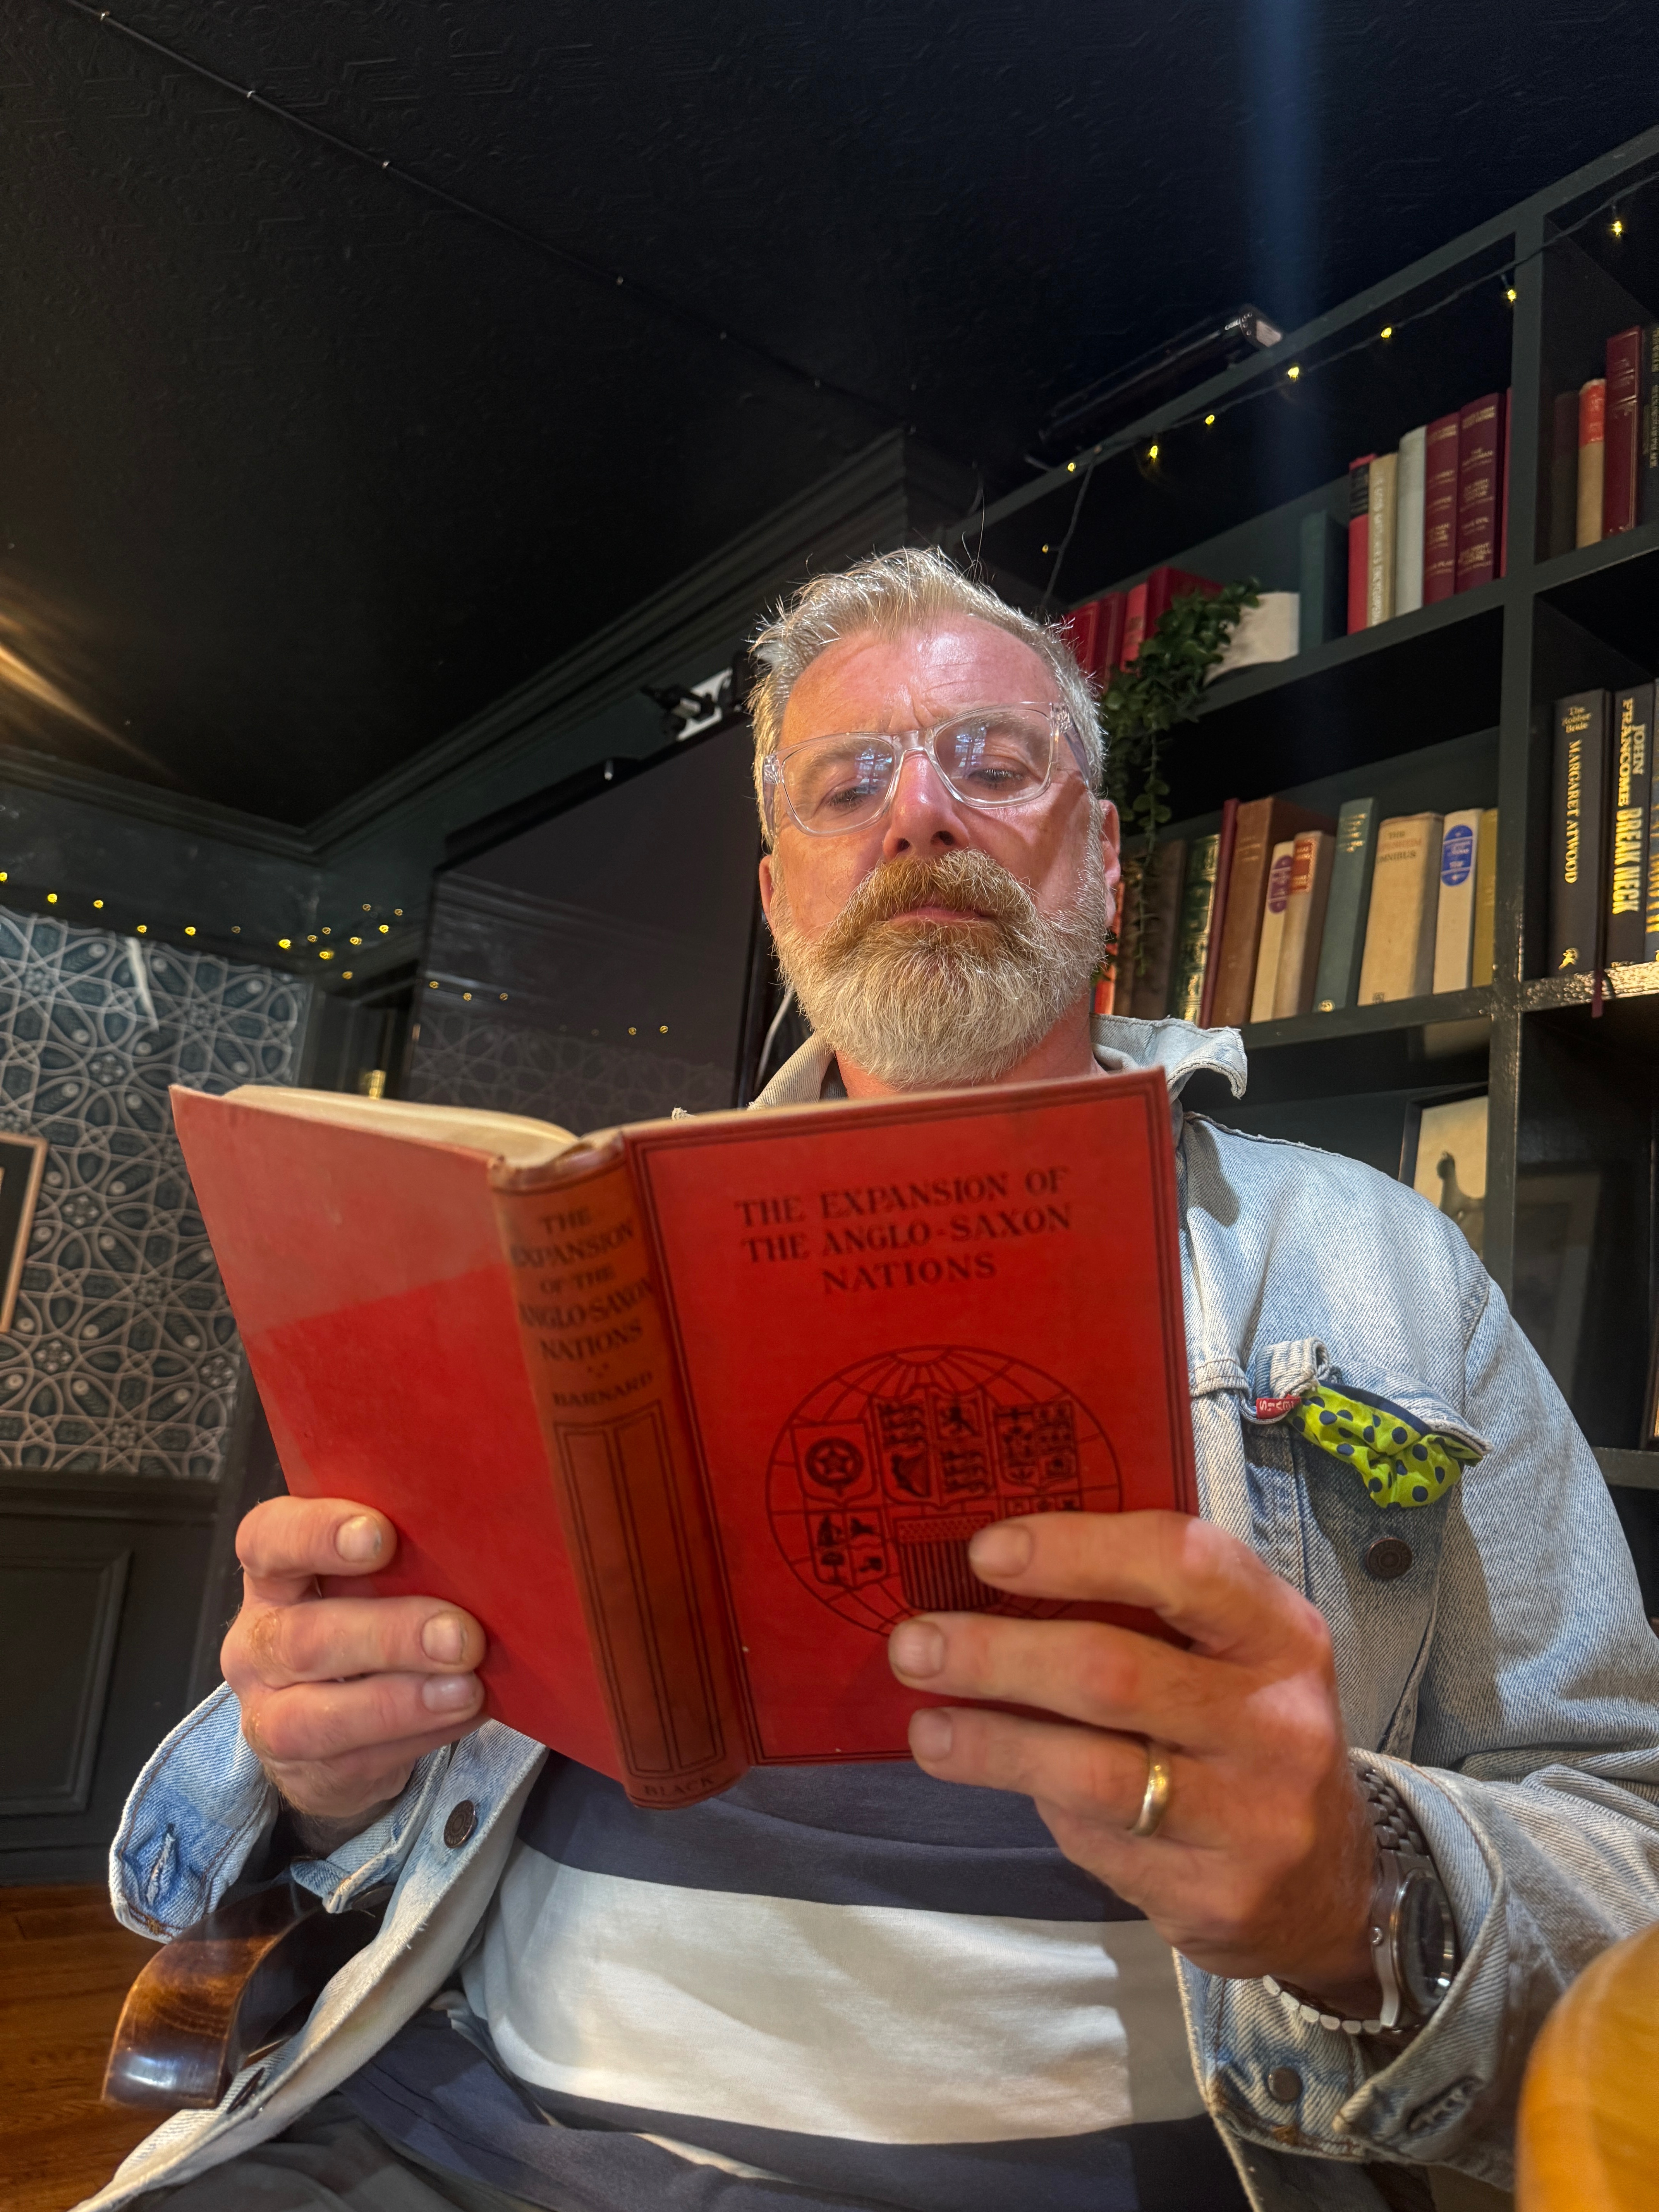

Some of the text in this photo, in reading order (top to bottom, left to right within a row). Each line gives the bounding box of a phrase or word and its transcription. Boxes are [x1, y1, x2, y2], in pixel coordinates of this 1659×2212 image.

[1618, 698, 1633, 807] FRANCOME
[1632, 724, 1645, 775] JOHN
[1565, 740, 1582, 883] MARGARET ATWOOD
[1613, 807, 1642, 914] BREAK NECK
[542, 1207, 591, 1234] THE
[735, 1166, 1069, 1227] THE EXPANSION OF
[742, 1202, 1073, 1263] THE ANGLO-SAXON
[574, 1266, 614, 1290] THE
[822, 1253, 996, 1295] NATIONS
[540, 1320, 643, 1360] NATIONS
